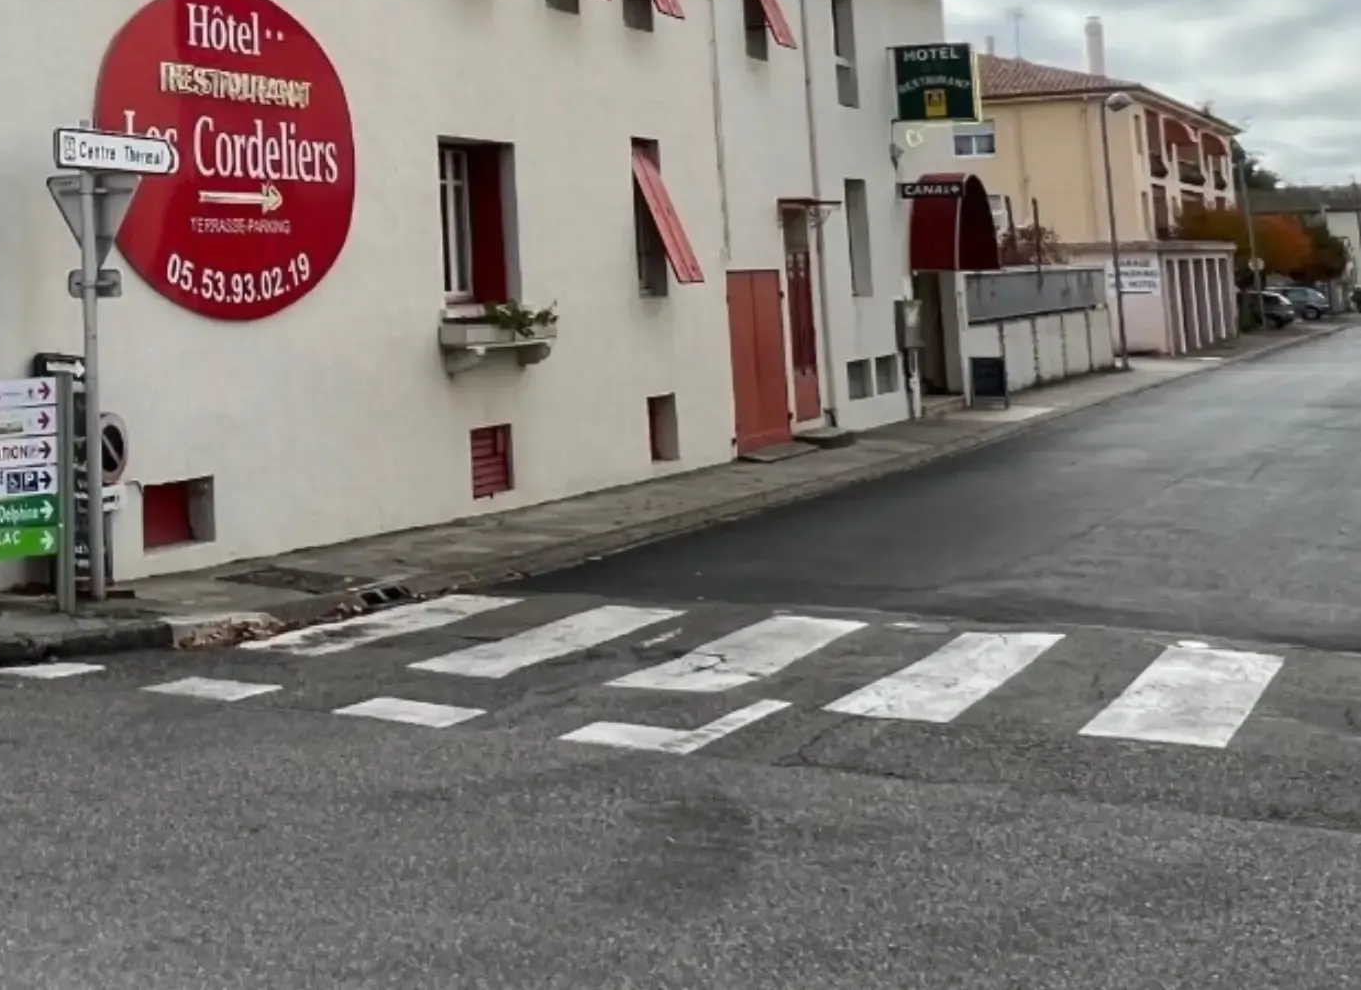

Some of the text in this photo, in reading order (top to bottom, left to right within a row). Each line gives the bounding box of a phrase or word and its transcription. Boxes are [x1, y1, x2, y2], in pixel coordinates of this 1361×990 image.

[187, 2, 261, 57] Hôtel
[903, 47, 960, 62] HOTEL
[79, 141, 165, 165] Centre Thermal
[193, 115, 338, 183] Cordeliers
[166, 253, 311, 303] 05.53.93.02.19
